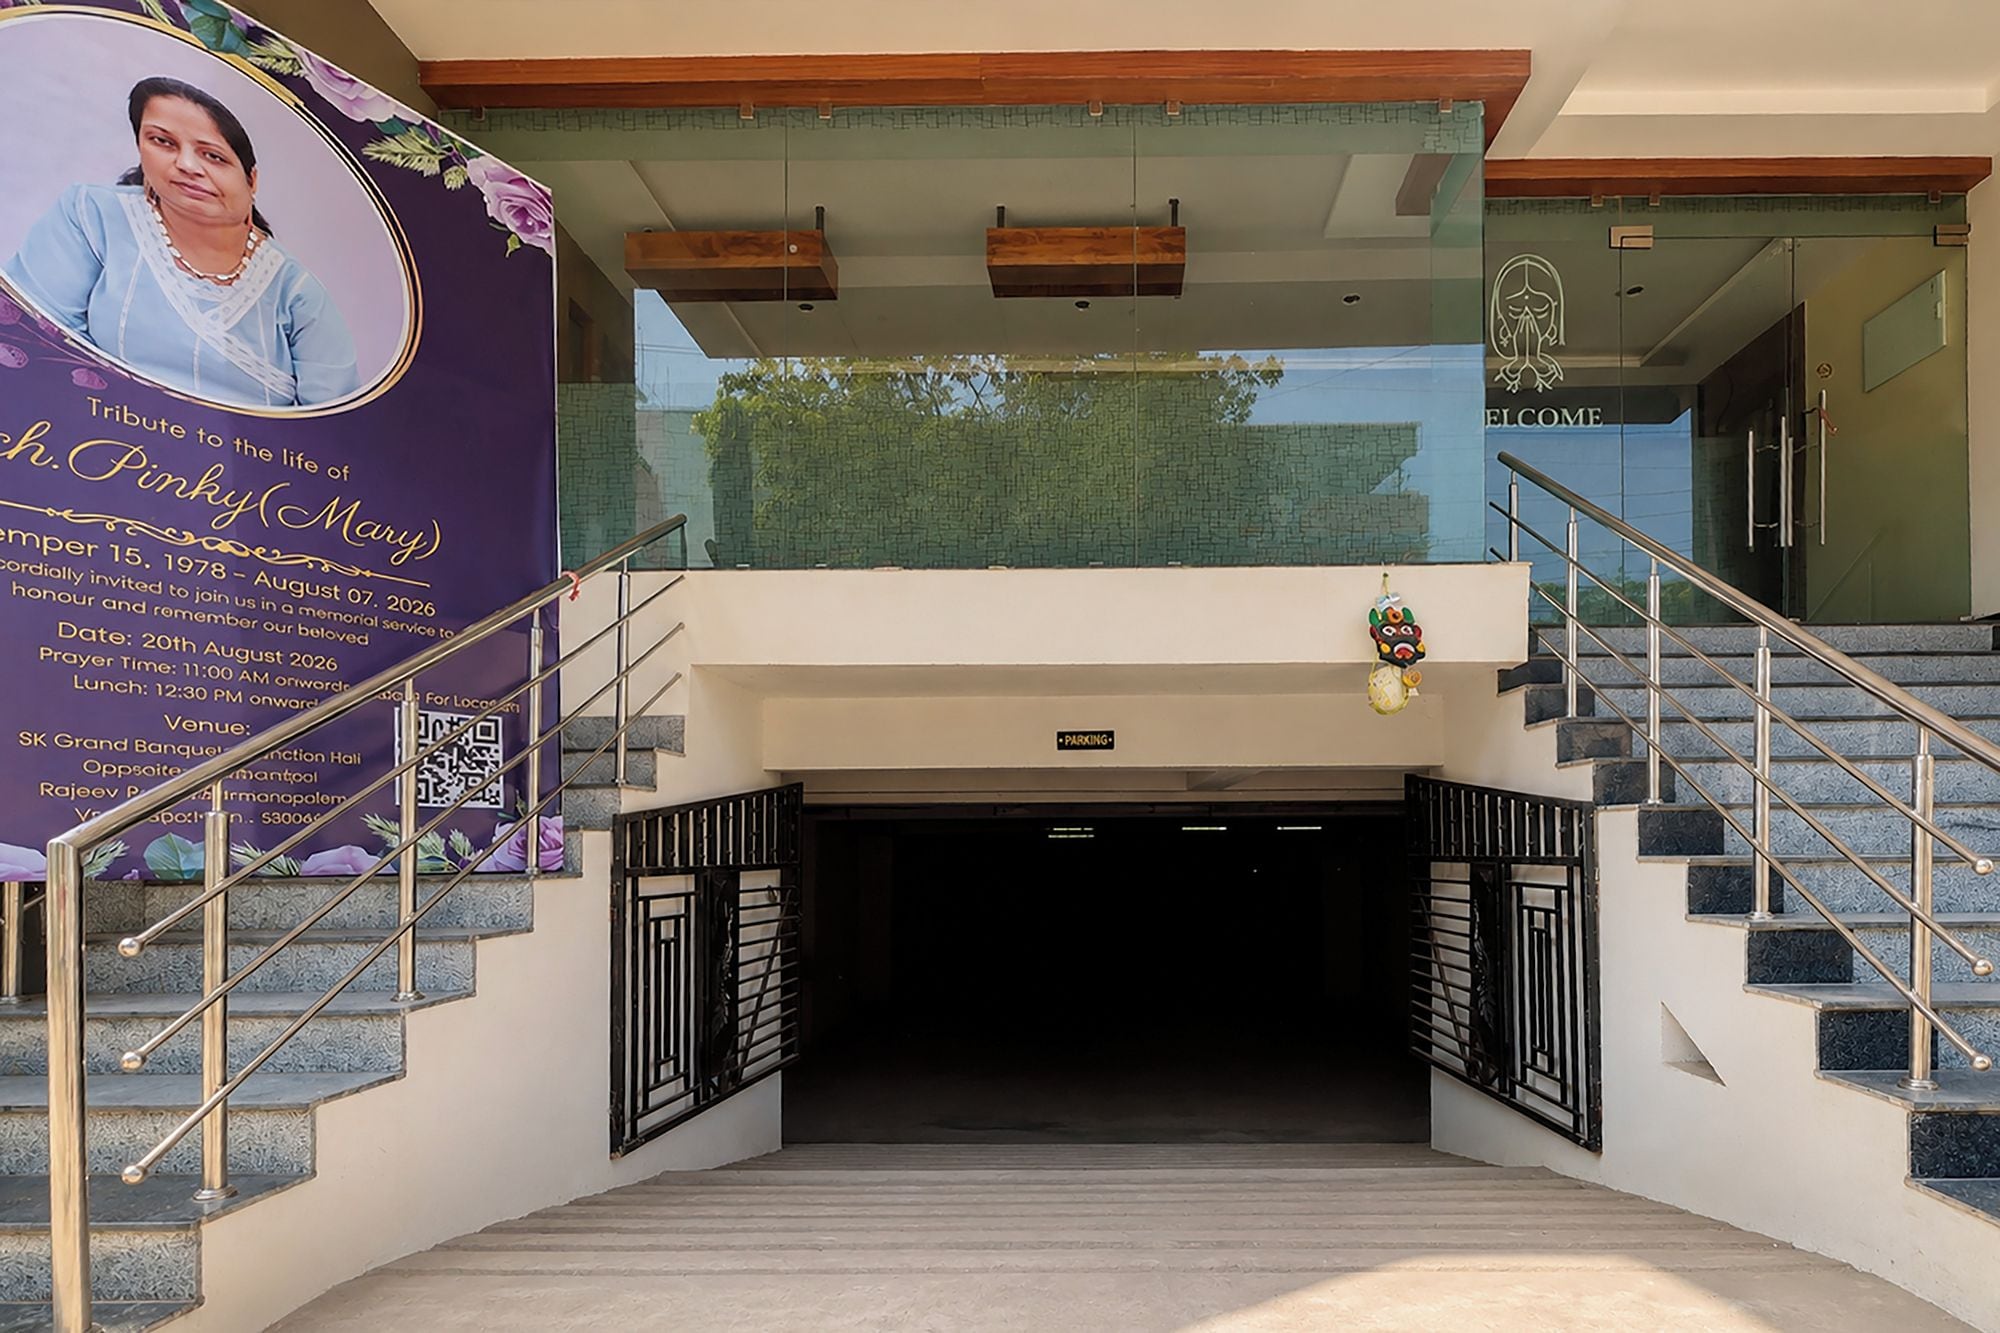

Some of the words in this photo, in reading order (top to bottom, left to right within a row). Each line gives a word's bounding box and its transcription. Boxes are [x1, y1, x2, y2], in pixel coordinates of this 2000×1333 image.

[1486, 407, 1604, 428] ELCOME
[87, 396, 186, 439] Tribute
[196, 427, 223, 448] to
[233, 437, 273, 462] the
[283, 448, 318, 473] life
[327, 464, 350, 481] of
[0, 528, 99, 556] mper
[164, 553, 226, 580] 1978
[254, 570, 340, 600] August
[387, 594, 436, 617] 2026
[12, 580, 95, 607] honour
[102, 598, 146, 615] and
[154, 604, 258, 629] remember
[263, 621, 294, 634] our
[298, 623, 369, 645] beloved
[90, 569, 162, 596] invited
[169, 582, 189, 599] to
[195, 587, 230, 603] join
[235, 596, 256, 609] us
[261, 597, 277, 612] in
[281, 603, 294, 614] a
[298, 606, 379, 628] memorial
[382, 619, 436, 637] service
[440, 628, 455, 639] to
[57, 621, 132, 646] Date:
[142, 632, 197, 654] 20th
[203, 640, 283, 664] August
[289, 652, 338, 671] 2026
[40, 646, 114, 668] Prayer
[121, 655, 176, 675] Time:
[183, 662, 233, 680] 11:00
[239, 670, 269, 684] AM
[74, 674, 148, 695] Lunch:
[156, 682, 208, 700] 12:30
[214, 688, 243, 703] PM
[249, 694, 319, 710] onward
[164, 714, 251, 736] Venue:
[1065, 735, 1108, 746] PARKING
[19, 731, 47, 747] SK
[54, 733, 128, 751] Grand
[262, 749, 325, 765] nction
[40, 782, 119, 801] Rajeev
